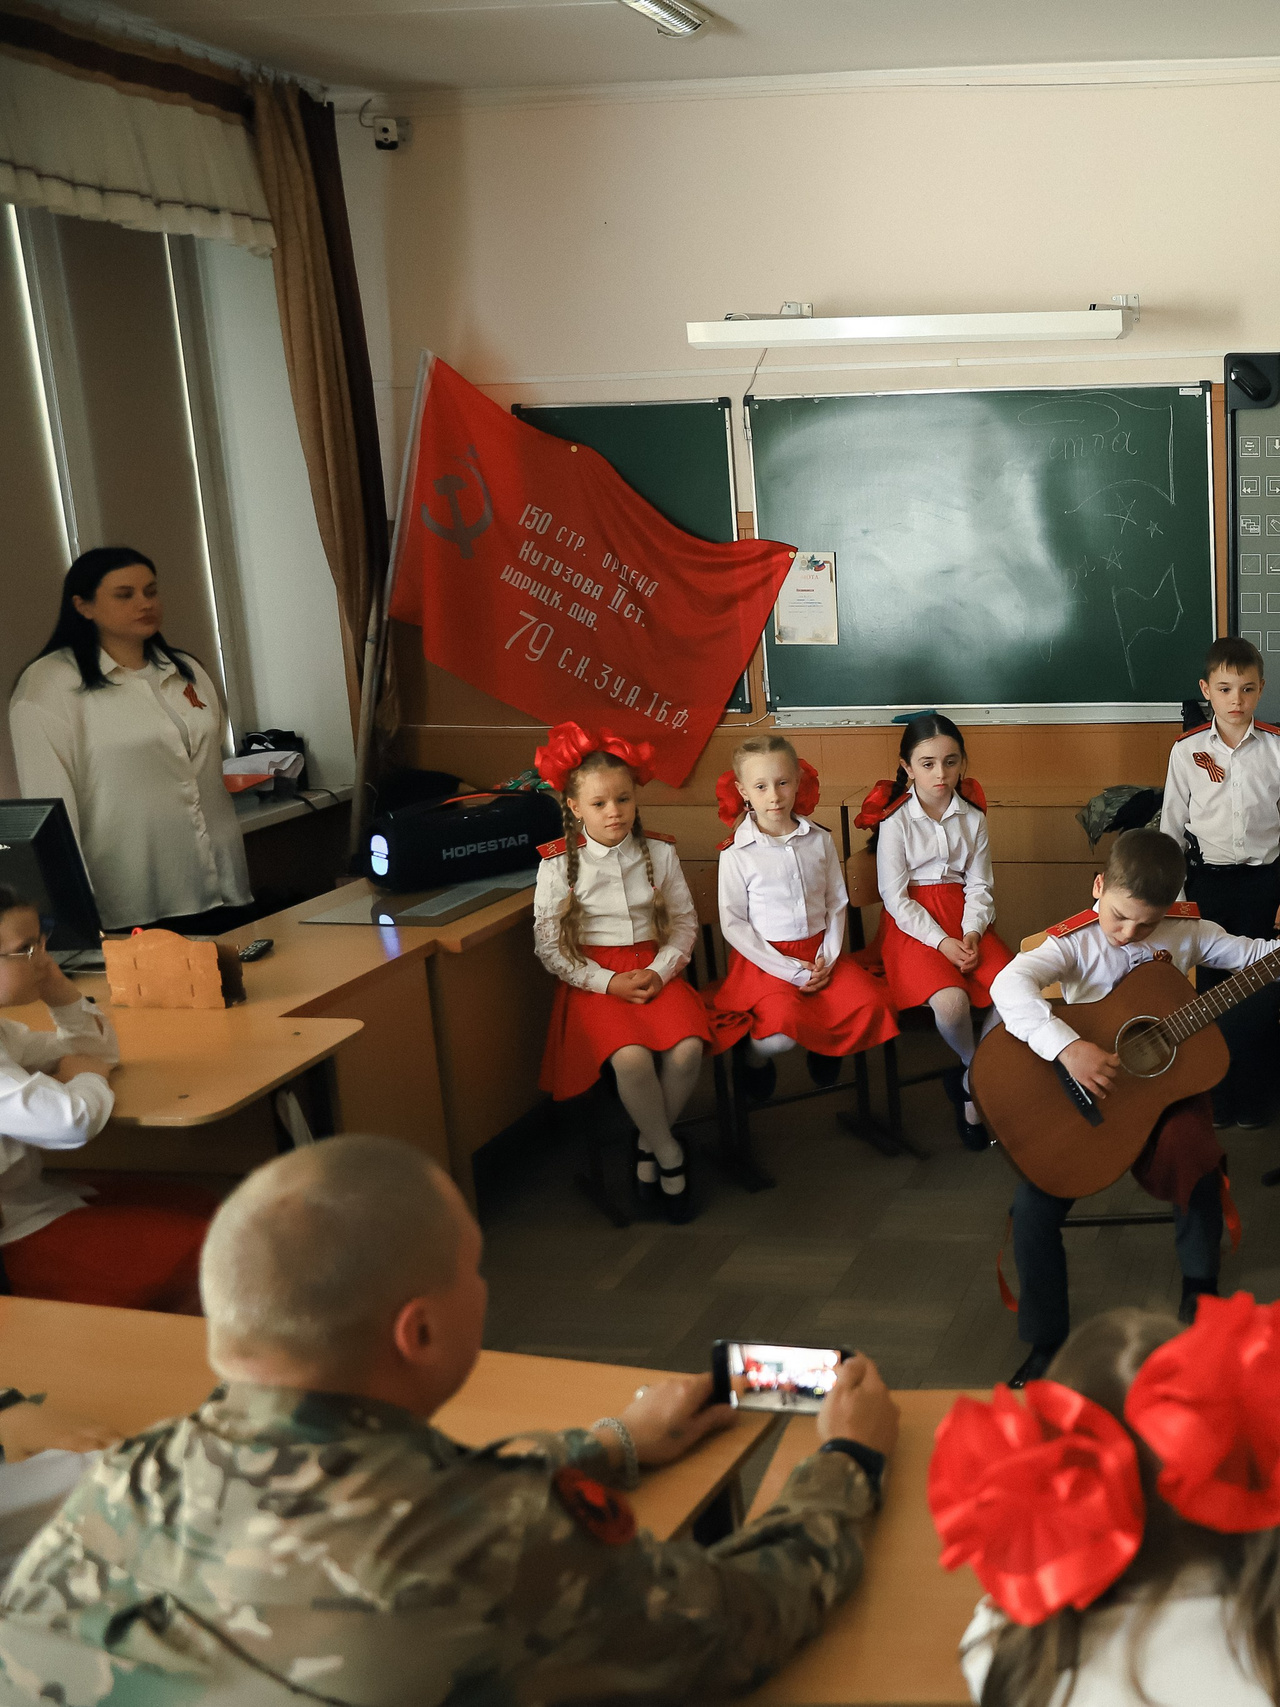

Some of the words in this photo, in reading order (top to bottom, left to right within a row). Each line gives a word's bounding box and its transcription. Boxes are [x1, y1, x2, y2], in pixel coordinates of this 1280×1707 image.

[518, 503, 553, 535] 150
[556, 526, 586, 556] СТР.
[602, 552, 660, 597] ОРДЕНА
[504, 610, 554, 662] 79
[594, 663, 613, 690] 3
[442, 834, 529, 861] HOPESTAR
